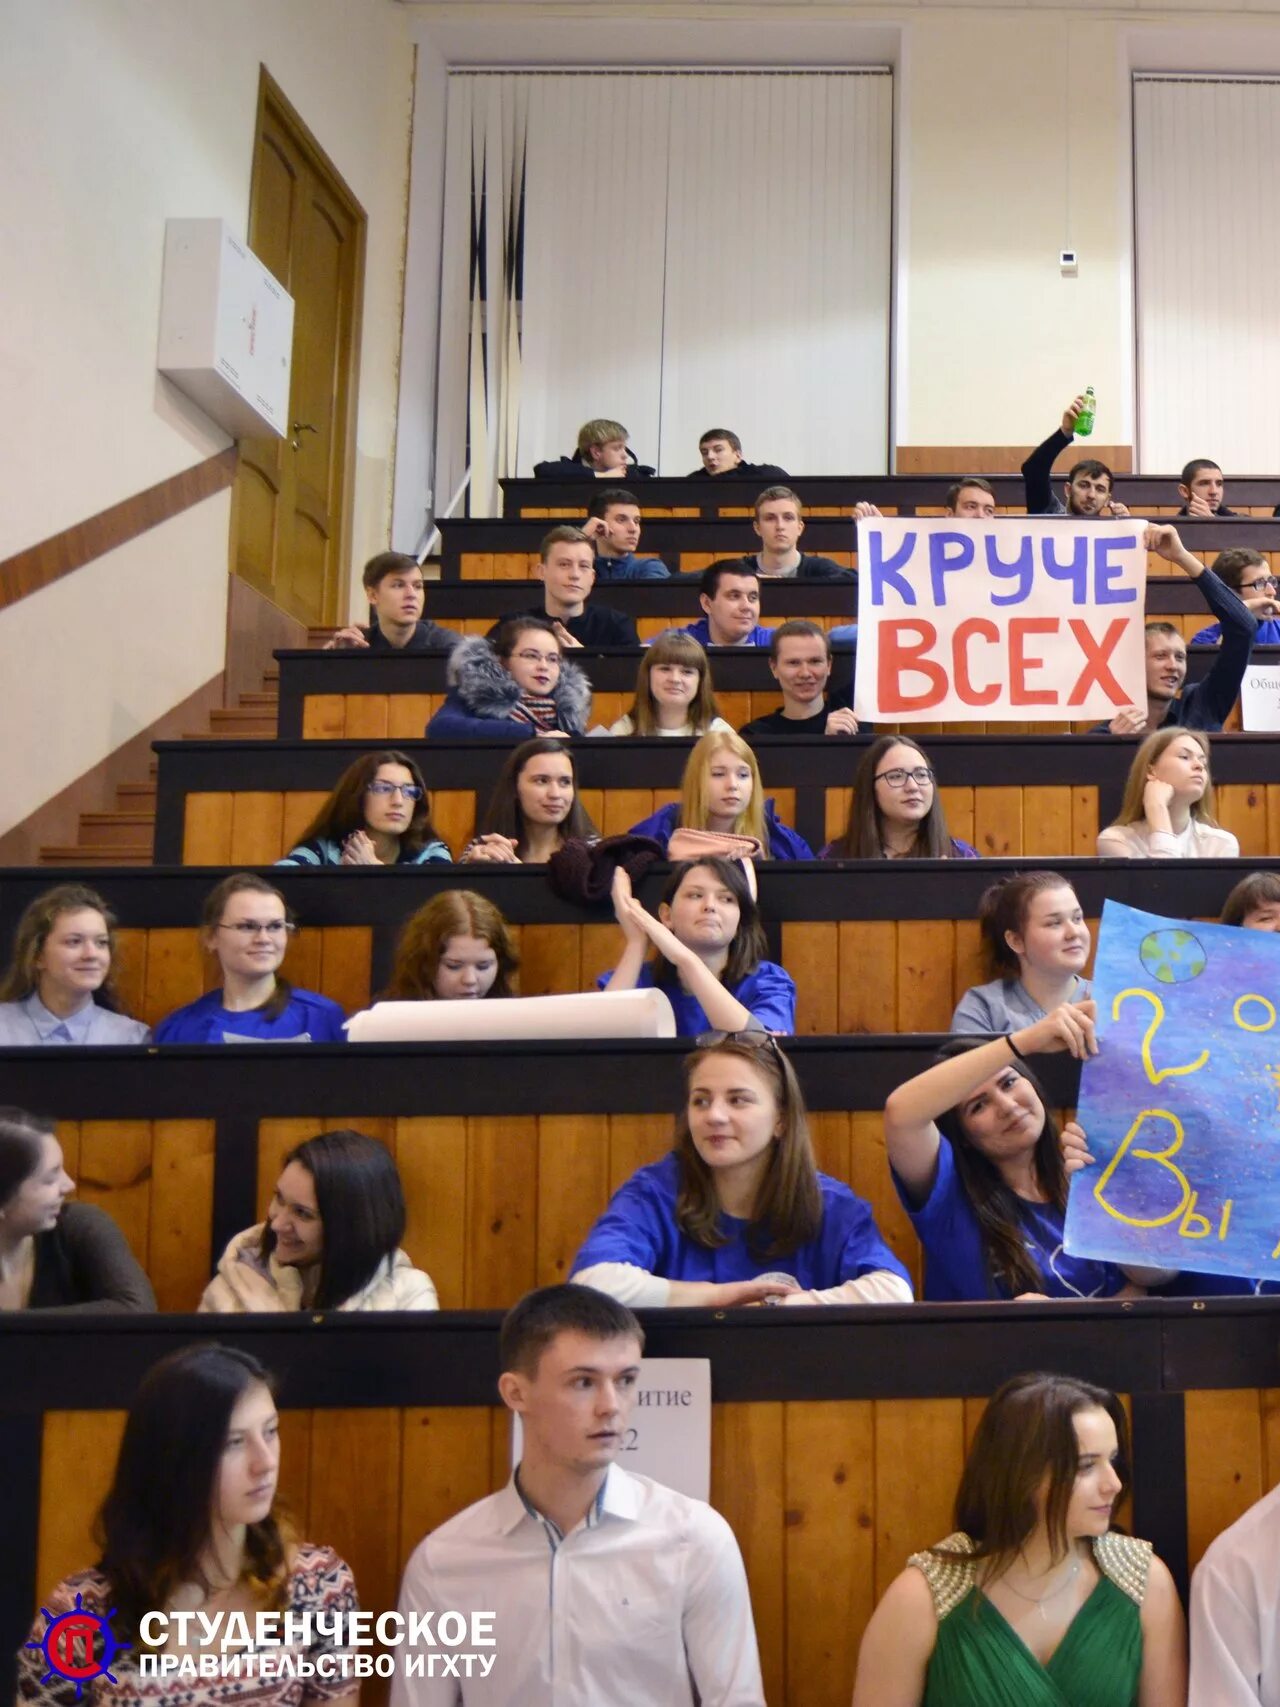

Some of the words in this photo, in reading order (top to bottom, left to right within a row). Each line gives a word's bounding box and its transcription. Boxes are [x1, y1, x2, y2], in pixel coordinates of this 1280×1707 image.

[868, 531, 1137, 606] КРУЧЕ
[877, 617, 1135, 713] ВСЕХ
[1111, 987, 1210, 1086] 2
